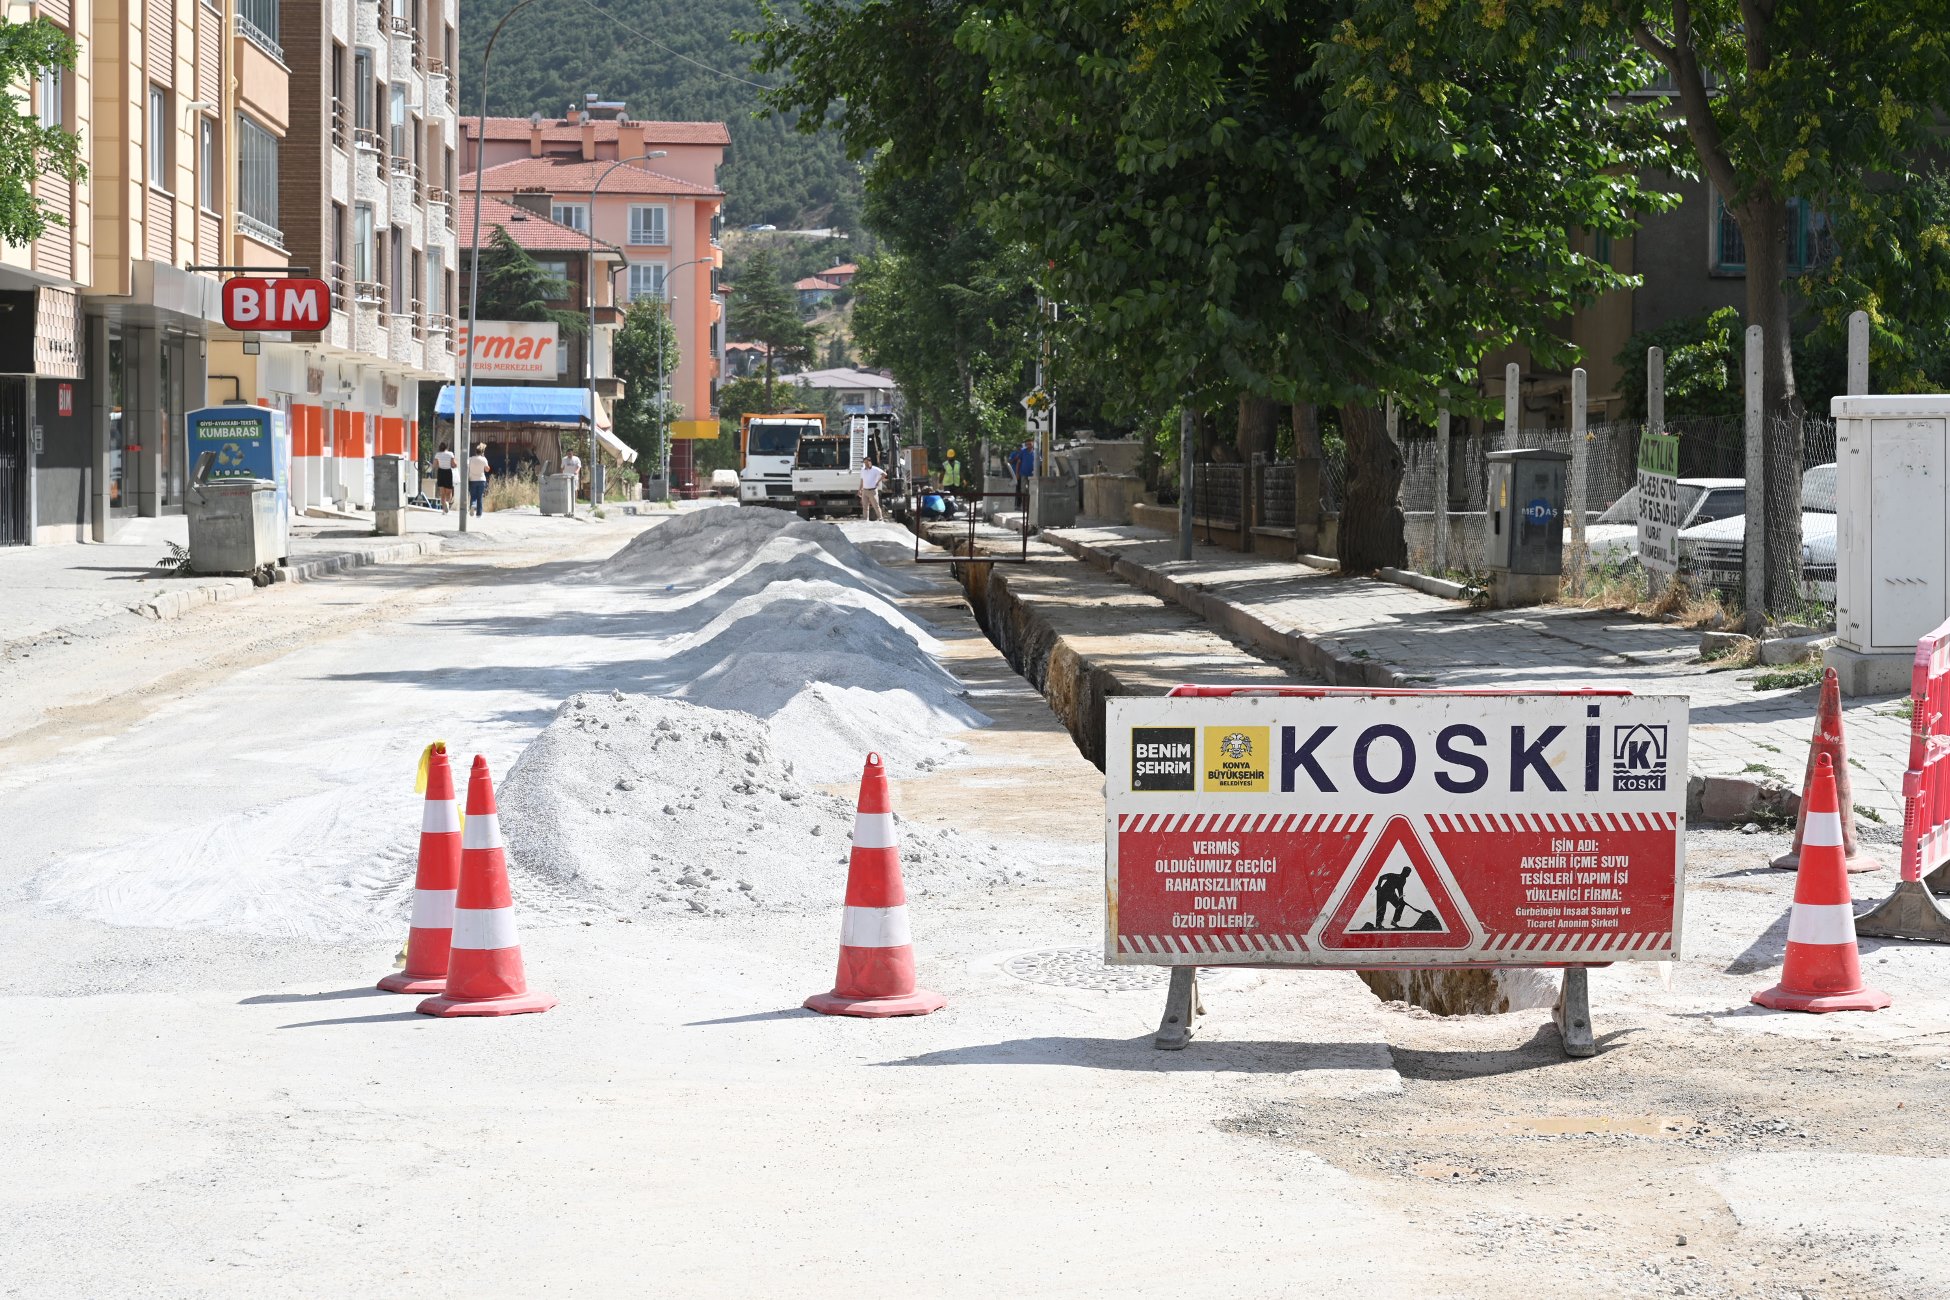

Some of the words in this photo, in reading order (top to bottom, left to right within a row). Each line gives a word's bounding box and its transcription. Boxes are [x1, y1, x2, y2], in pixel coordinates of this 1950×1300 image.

[233, 279, 318, 322] BİM
[59, 384, 72, 410] BİM
[200, 427, 259, 438] KUMBARASI
[1641, 438, 1674, 472] SATILIK
[1521, 505, 1558, 518] MEDAŞ
[1136, 743, 1191, 758] BENİM
[1281, 705, 1601, 794] KOSKİ
[1136, 761, 1191, 776] ŞEHRİM
[1222, 762, 1250, 770] KONYA
[1208, 769, 1265, 780] BÜYÜKŞEHİR
[1219, 779, 1253, 787] BELEDİYESİ
[1618, 776, 1661, 790] KOSKİ
[1193, 838, 1240, 856] VERMİŞ
[1551, 837, 1574, 853] İŞİN
[1577, 840, 1599, 852] ADI:
[1155, 857, 1232, 873] OLDUĞUMUZ
[1235, 857, 1277, 875] GEÇİCİ
[1520, 854, 1567, 869] AKŞEHİR
[1570, 854, 1598, 870] İÇME
[1601, 856, 1629, 868] SUYU
[1165, 878, 1267, 892] RAHATSIZLIKTAN
[1520, 870, 1573, 885] TESİSLERİ
[1576, 872, 1611, 884] YAPIM
[1614, 869, 1629, 886] İŞİ
[1525, 886, 1581, 902] YÜKLENİCİ
[1584, 886, 1623, 900] FİRMA:
[1194, 896, 1237, 910] DOLAYI
[1590, 905, 1619, 917] Sanayi
[1621, 907, 1631, 915] ve
[1172, 912, 1205, 928] ÖZÜR
[1527, 918, 1556, 928] Ticaret
[1558, 918, 1589, 928] Anonim
[1591, 918, 1619, 929] Şirketi
